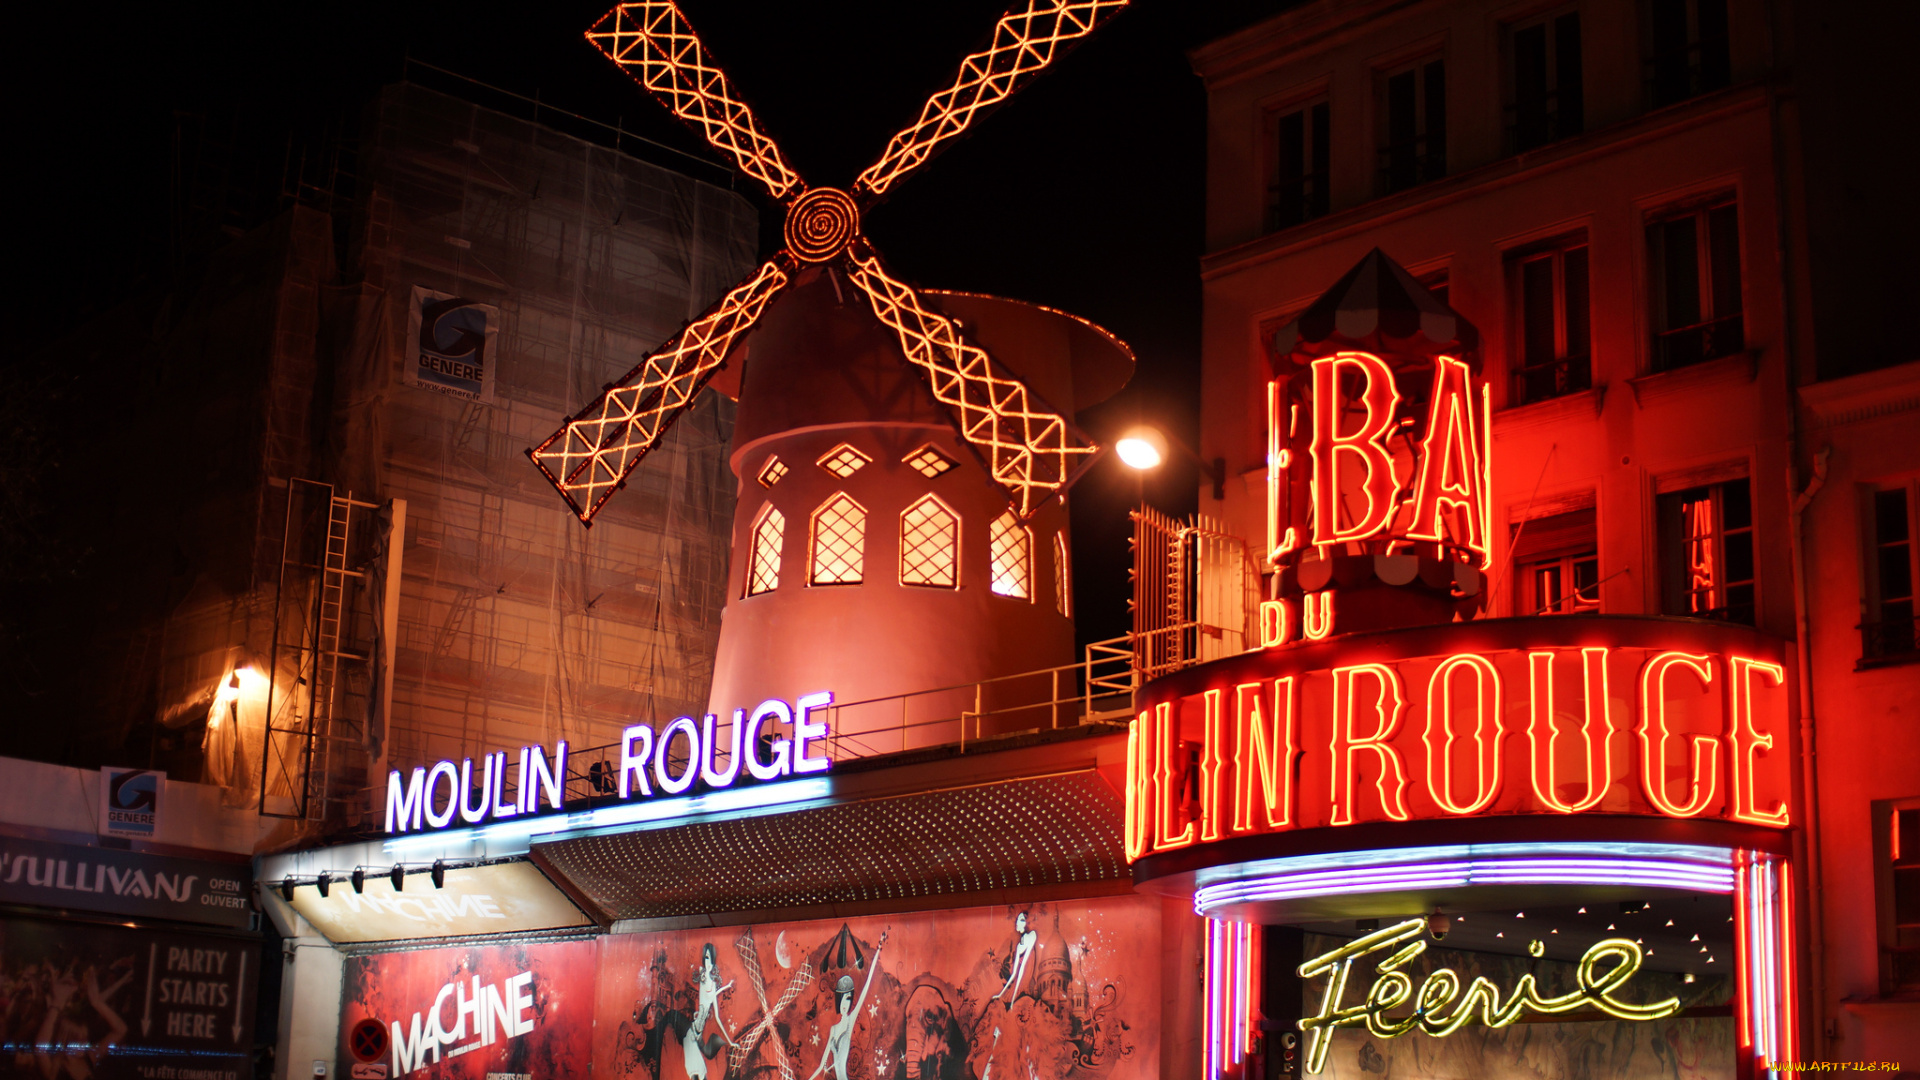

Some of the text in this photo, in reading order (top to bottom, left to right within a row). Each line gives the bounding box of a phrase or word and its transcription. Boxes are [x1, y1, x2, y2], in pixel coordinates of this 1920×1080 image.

[419, 354, 484, 382] GENERE
[416, 380, 481, 401] www.genere.fr
[1260, 591, 1334, 648] DU
[384, 690, 835, 834] MOULIN ROUGE
[1125, 645, 1791, 865] ULIN ROUGE
[108, 811, 155, 825] GENERE
[0, 853, 199, 902] 'SULLIVANS
[209, 878, 240, 893] OPEN
[200, 894, 247, 909] OUVERT
[167, 946, 229, 975] PARTY
[159, 978, 229, 1008] STARTS
[1298, 917, 1681, 1076] Féerie
[166, 1012, 216, 1039] HERE
[391, 970, 535, 1079] MACHINE
